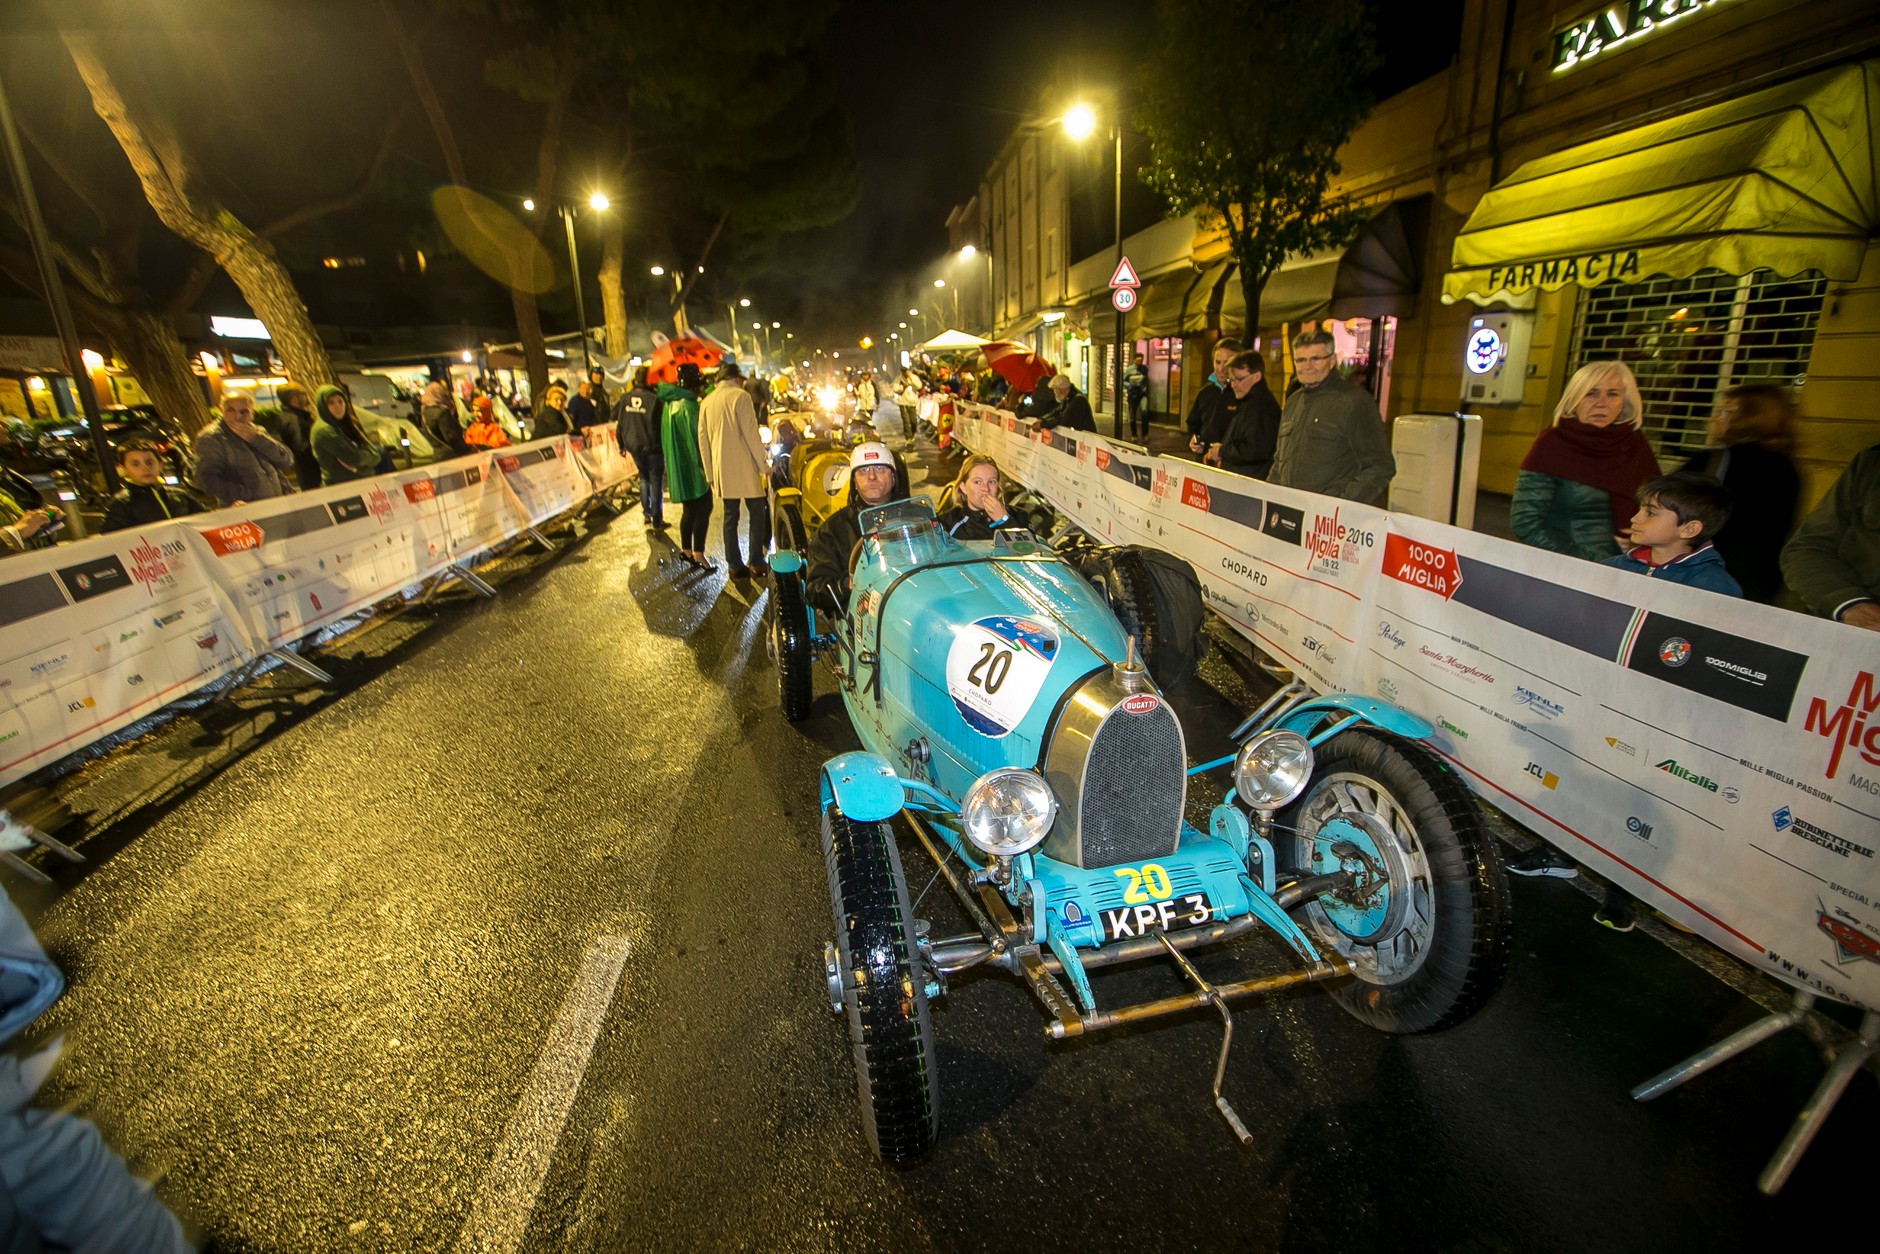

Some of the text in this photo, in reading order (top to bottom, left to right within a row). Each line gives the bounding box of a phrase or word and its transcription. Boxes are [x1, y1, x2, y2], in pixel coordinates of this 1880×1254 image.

[1552, 0, 1718, 70] FAR
[1489, 250, 1640, 290] FARMACIA
[1119, 294, 1132, 304] 30
[852, 433, 866, 443] 21
[219, 524, 251, 540] 1000
[1315, 506, 1375, 548] Mille 2016
[129, 534, 161, 564] Mille
[1305, 530, 1340, 571] Miglia
[1408, 544, 1446, 570] 1000
[1221, 557, 1268, 587] CHOPARD
[1397, 563, 1447, 592] MIGLIA
[1261, 613, 1289, 636] Mercedes-Benz
[1376, 621, 1406, 650] Perlage
[966, 643, 1013, 695] 20
[1419, 645, 1495, 683] Santa Margherita
[67, 701, 84, 714] JCL
[968, 688, 992, 706] CHOPARD
[1126, 700, 1156, 710] BUGATTI
[1516, 685, 1565, 713] KIENLE
[1479, 705, 1528, 732] MILLE MIGLIA FRIEND
[1523, 761, 1544, 779] JCL
[1654, 758, 1719, 793] Alitalia
[1739, 759, 1833, 803] MILLE MIGLIA PASSION
[1790, 825, 1850, 857] BRESCIANE
[1793, 817, 1875, 858] RUBINETTERIE
[1114, 864, 1172, 904] 20
[1829, 881, 1870, 906] SPECIAL
[1108, 895, 1209, 939] KPF 3
